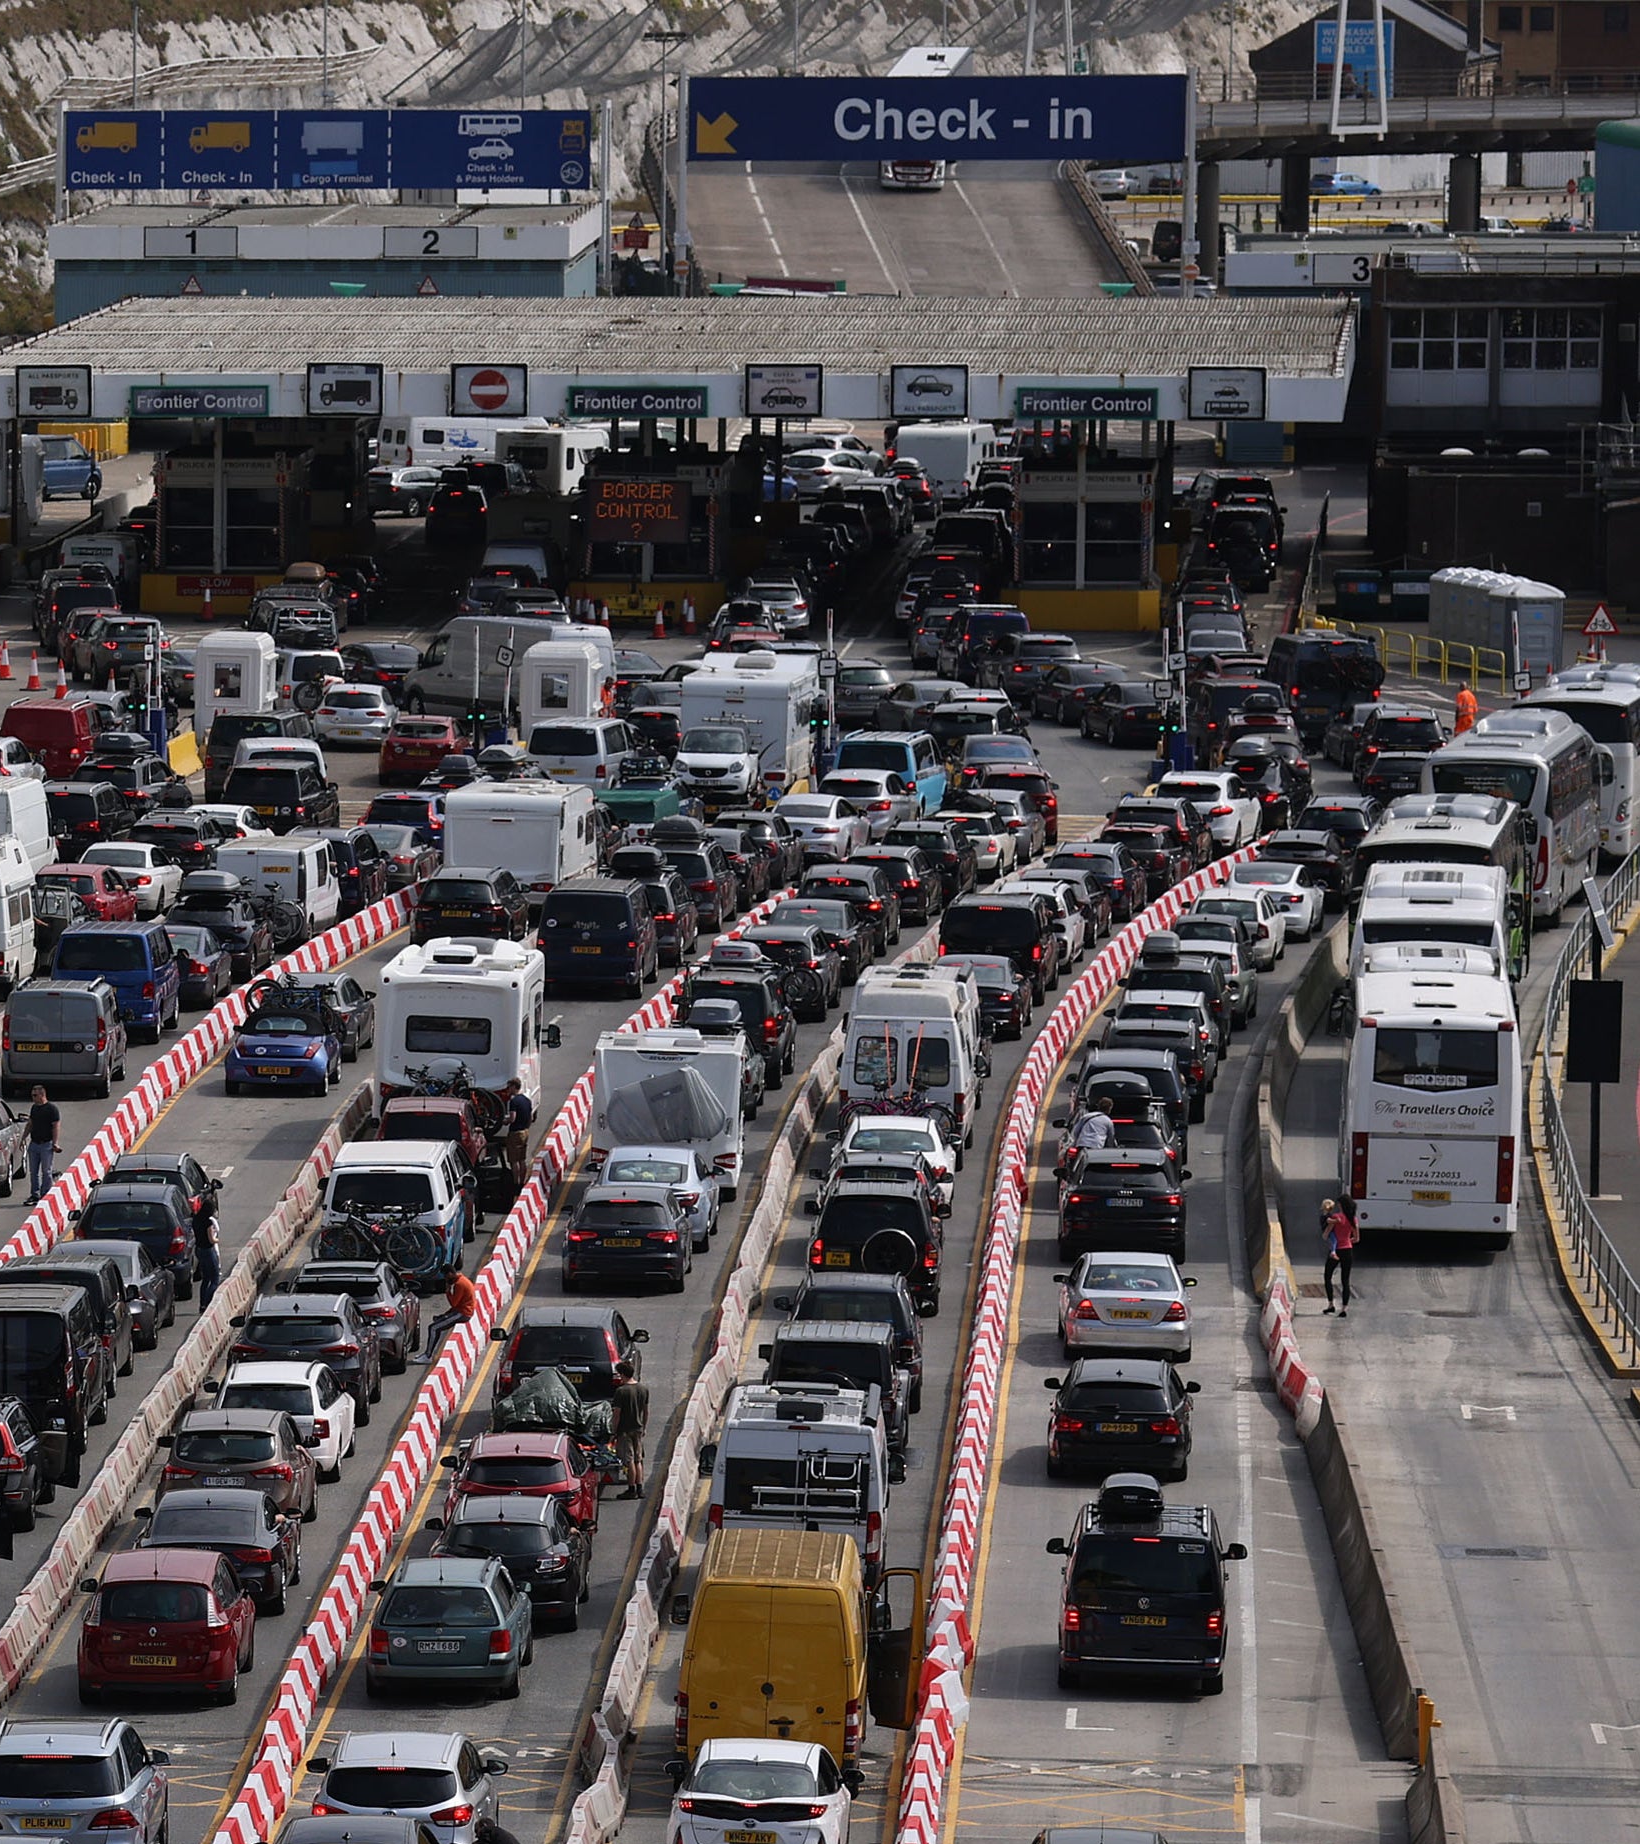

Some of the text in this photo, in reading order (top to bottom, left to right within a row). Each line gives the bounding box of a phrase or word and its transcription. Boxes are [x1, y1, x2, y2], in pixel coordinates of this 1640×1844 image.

[834, 97, 1092, 141] Check - in
[467, 163, 514, 172] Check In
[71, 170, 142, 184] Check In
[182, 170, 253, 184] Check In
[302, 173, 374, 185] Cargo Terminal
[465, 175, 487, 183] Pass
[489, 175, 524, 183] Holders
[184, 230, 197, 254] 1
[422, 230, 440, 254] 2
[1352, 256, 1370, 280] 3
[136, 394, 263, 409] Frontier Control
[574, 394, 702, 410] Frontier Control
[1023, 396, 1152, 413] Frontier Control
[602, 484, 673, 499] BORDER
[596, 502, 679, 519] CONTROL
[199, 577, 231, 588] SLOW
[1399, 1102, 1495, 1117] Travellers Choice
